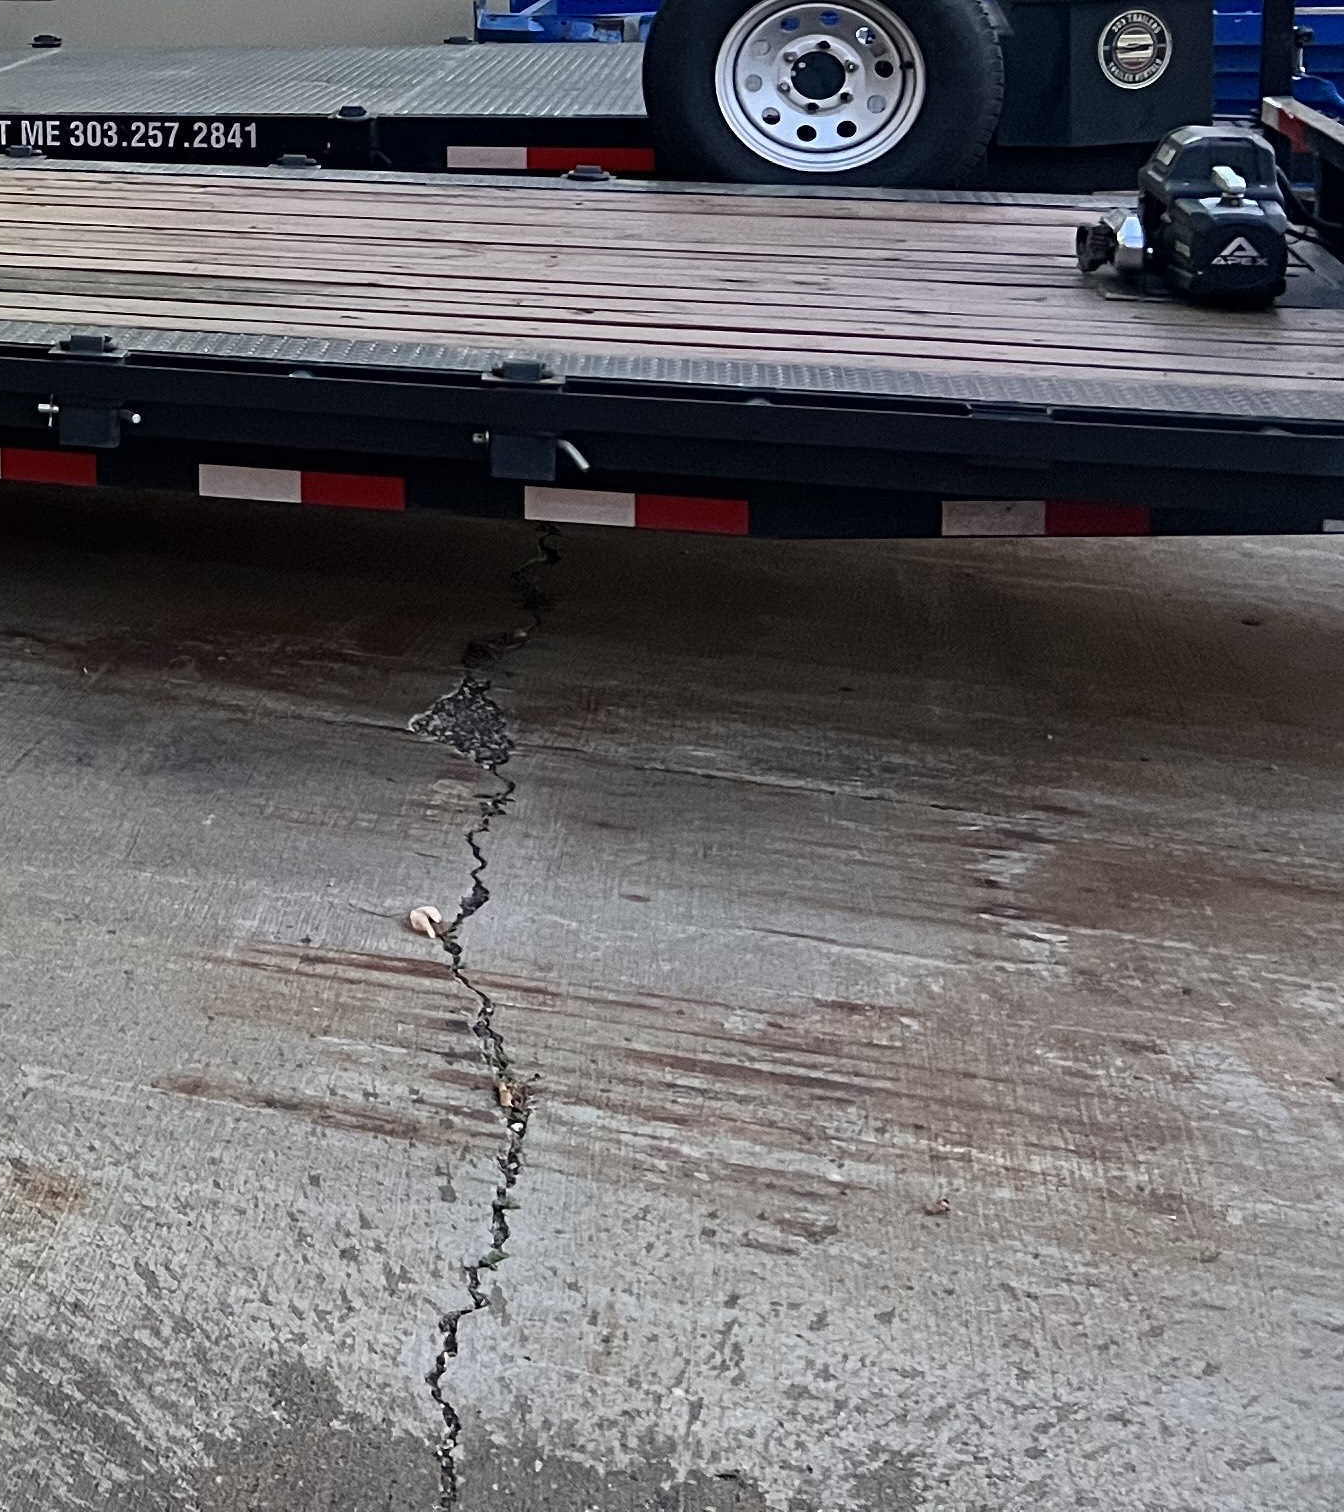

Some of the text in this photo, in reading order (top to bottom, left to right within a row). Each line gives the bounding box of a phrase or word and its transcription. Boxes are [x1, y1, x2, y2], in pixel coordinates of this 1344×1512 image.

[21, 120, 61, 147] ME
[69, 121, 258, 149] 303.257.2841
[1211, 256, 1268, 266] APEX
